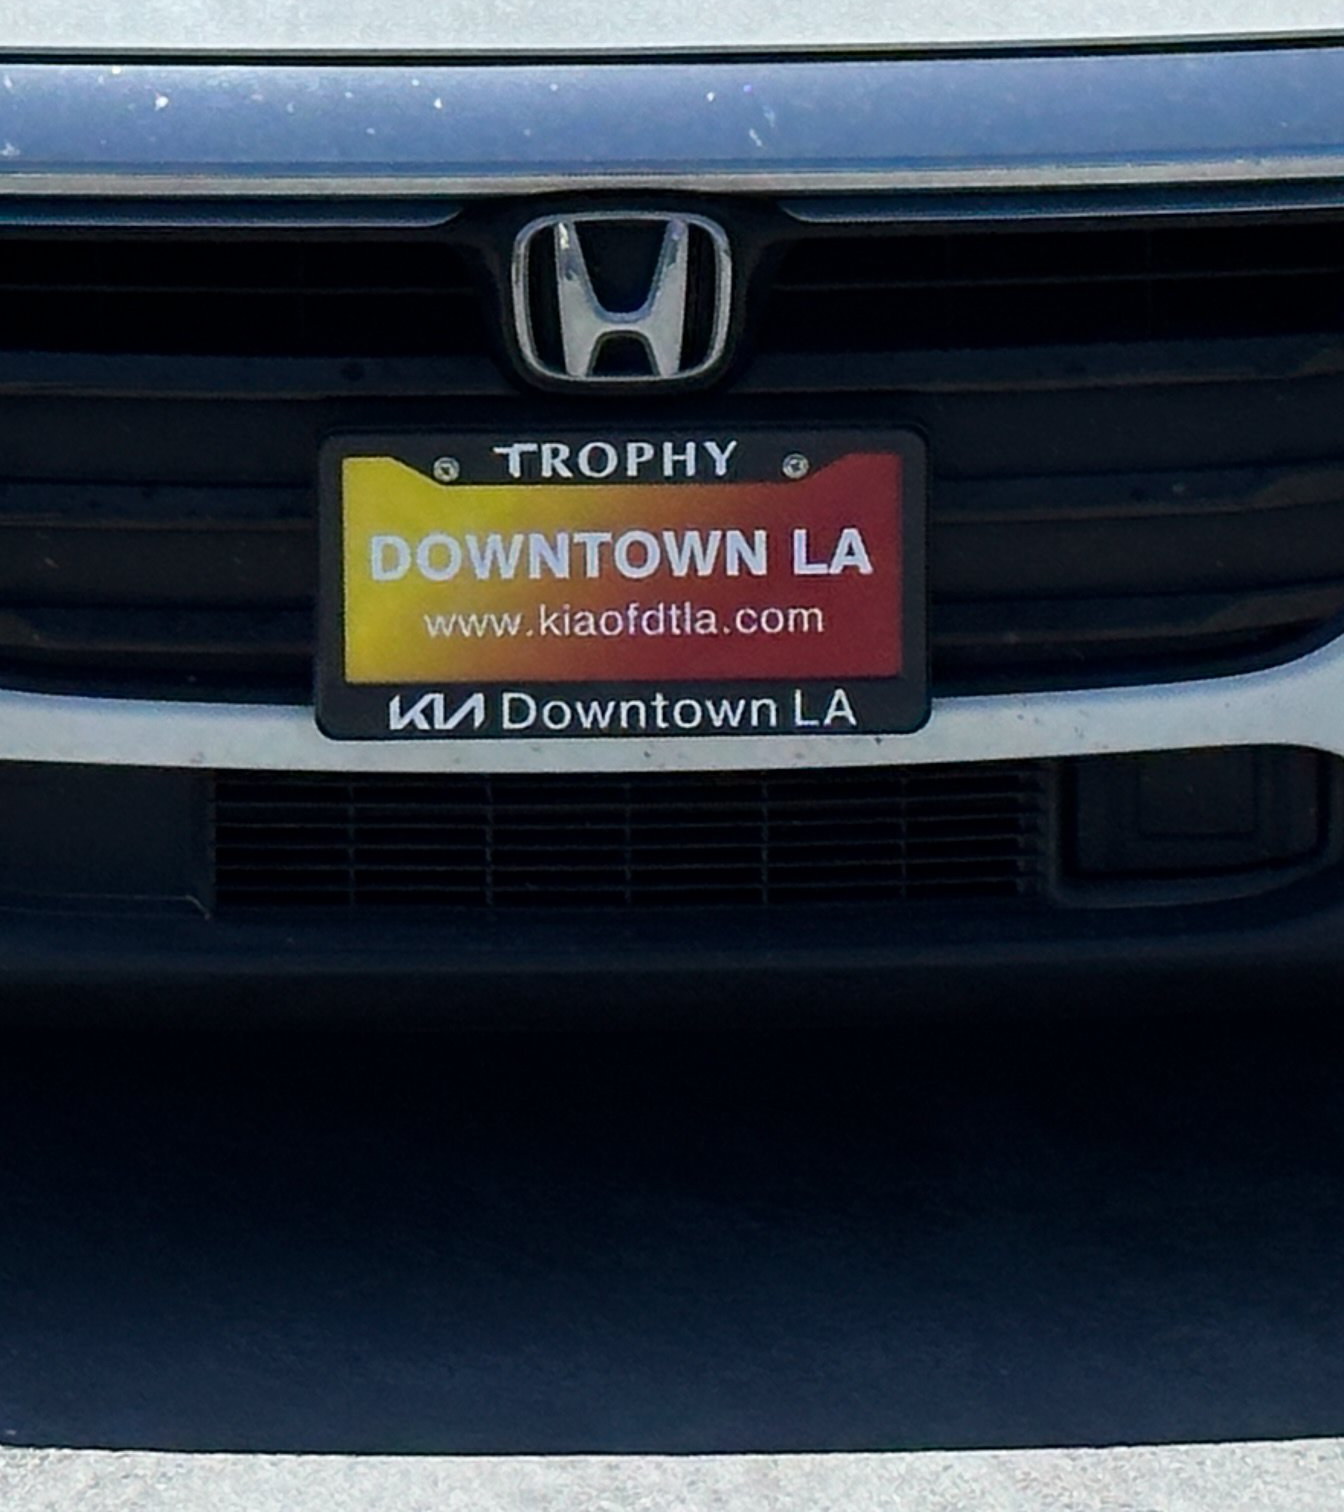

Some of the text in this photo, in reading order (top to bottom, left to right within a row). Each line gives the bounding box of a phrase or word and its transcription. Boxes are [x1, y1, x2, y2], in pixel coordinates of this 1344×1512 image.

[492, 439, 739, 480] TROPHY
[369, 527, 874, 583] DOWNTOWN LA
[423, 602, 825, 640] www.kiaofdtla.com
[387, 687, 857, 732] KIA Downtown LA
